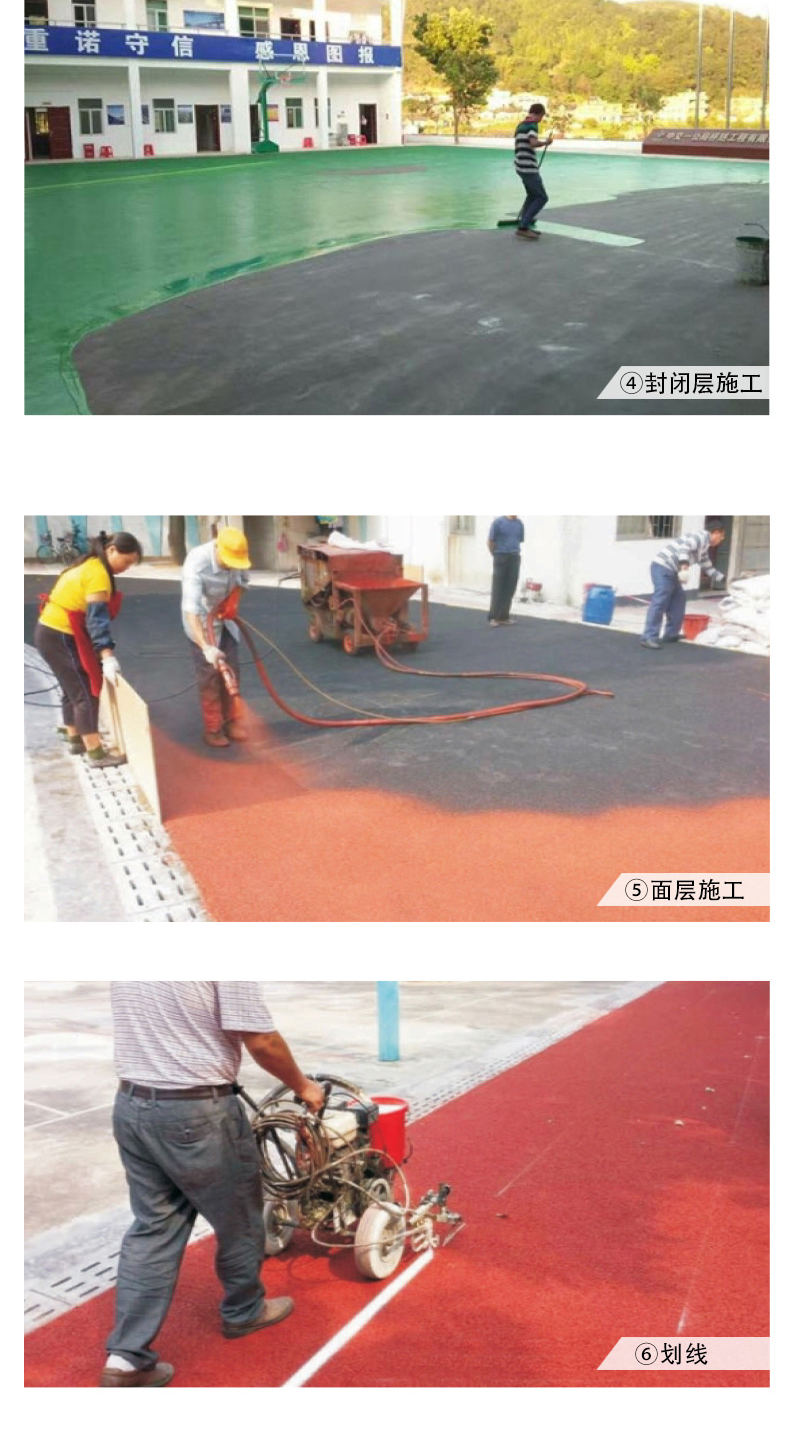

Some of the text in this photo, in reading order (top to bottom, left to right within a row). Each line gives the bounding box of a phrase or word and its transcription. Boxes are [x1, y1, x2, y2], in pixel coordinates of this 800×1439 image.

[24, 28, 374, 64] 重诺守信 感恩图报
